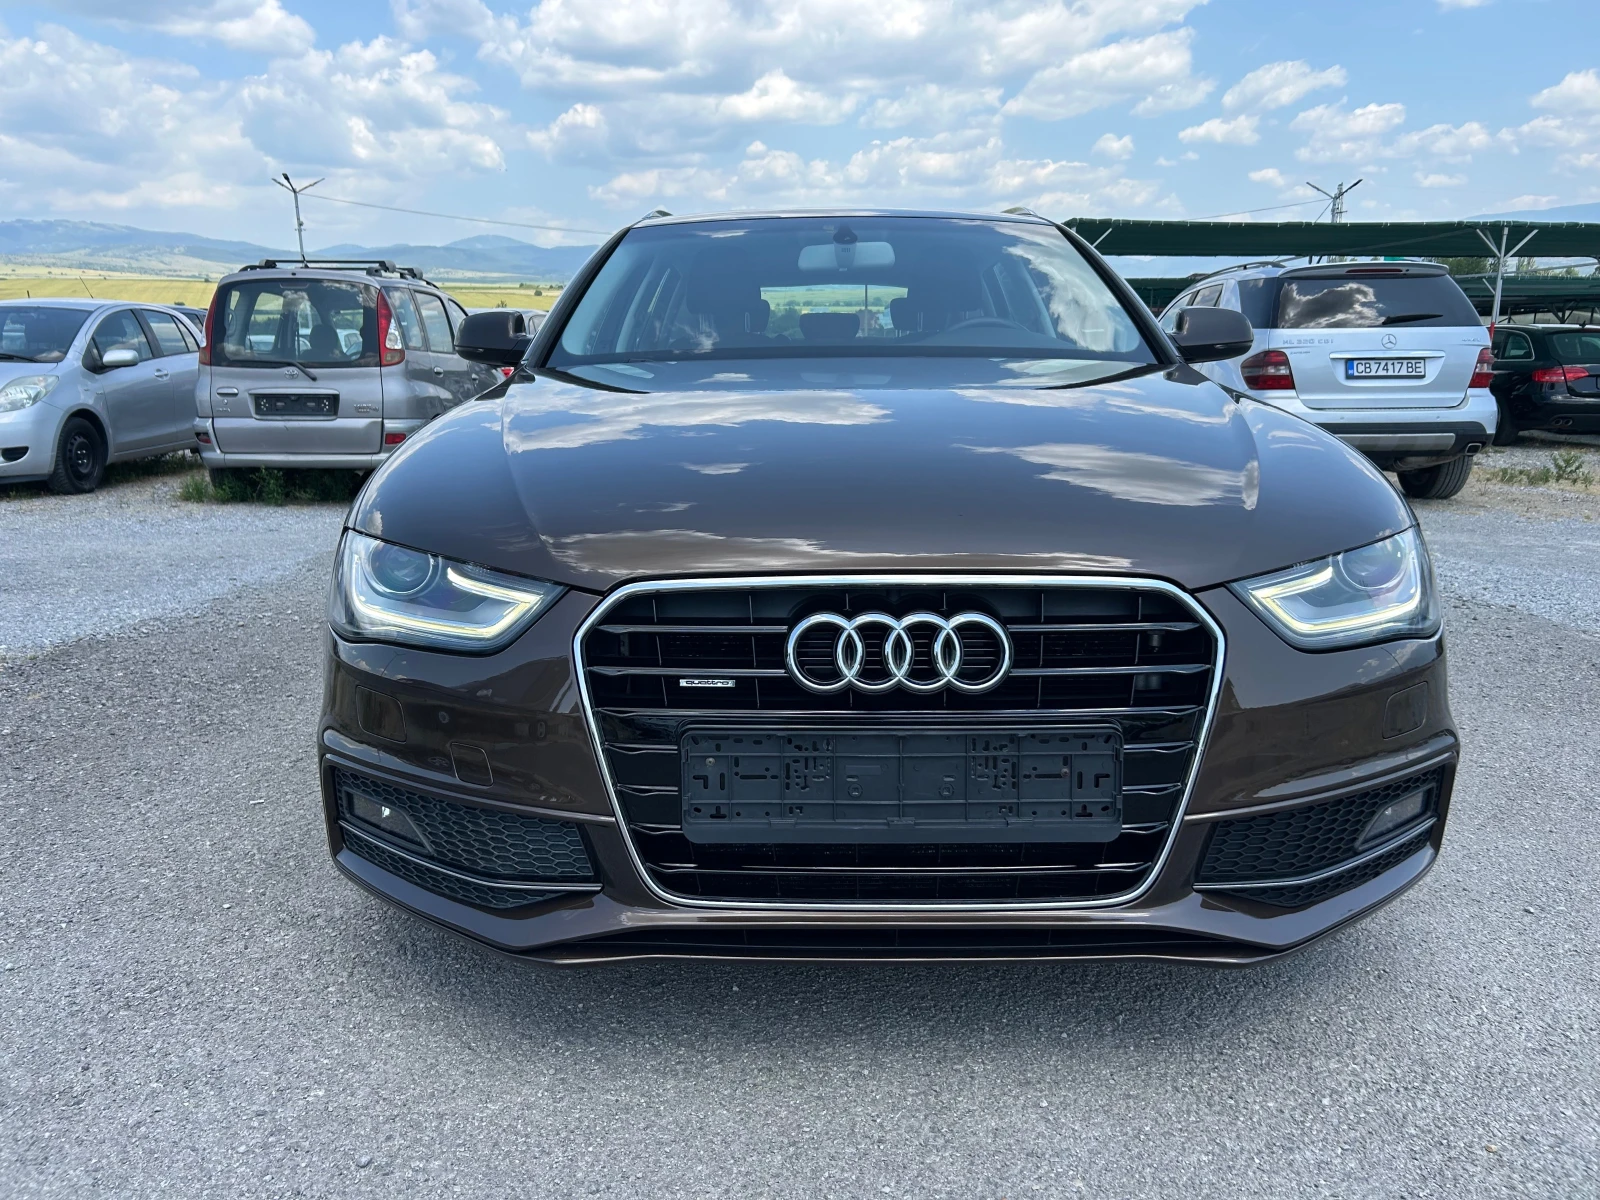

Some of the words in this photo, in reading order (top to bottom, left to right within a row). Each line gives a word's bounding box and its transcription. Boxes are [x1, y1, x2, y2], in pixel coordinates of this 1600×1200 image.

[1356, 362, 1372, 374] CB
[1374, 361, 1404, 374] 7417
[1406, 361, 1422, 374] BE
